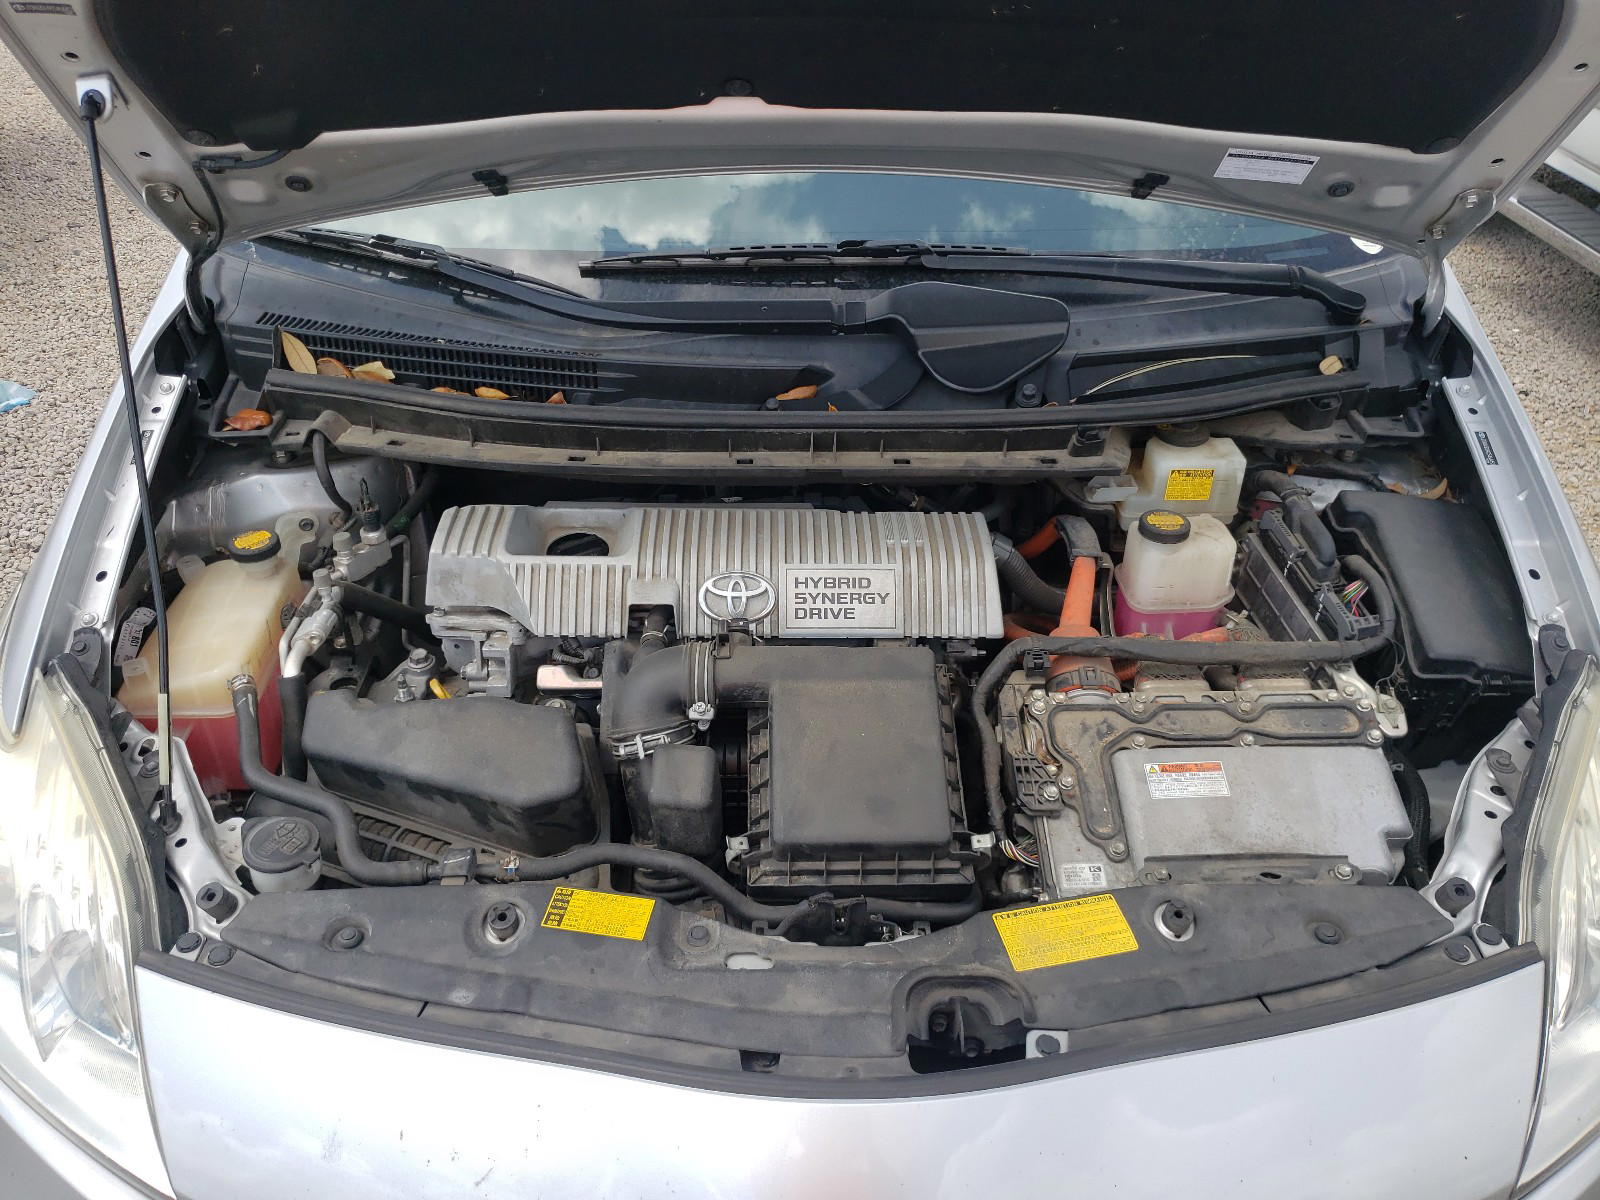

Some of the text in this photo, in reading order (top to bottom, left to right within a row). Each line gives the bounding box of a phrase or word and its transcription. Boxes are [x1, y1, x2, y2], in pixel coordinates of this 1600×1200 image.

[794, 577, 872, 589] HYBRID
[794, 592, 890, 605] SYNERGY
[794, 607, 856, 620] DRIVE
